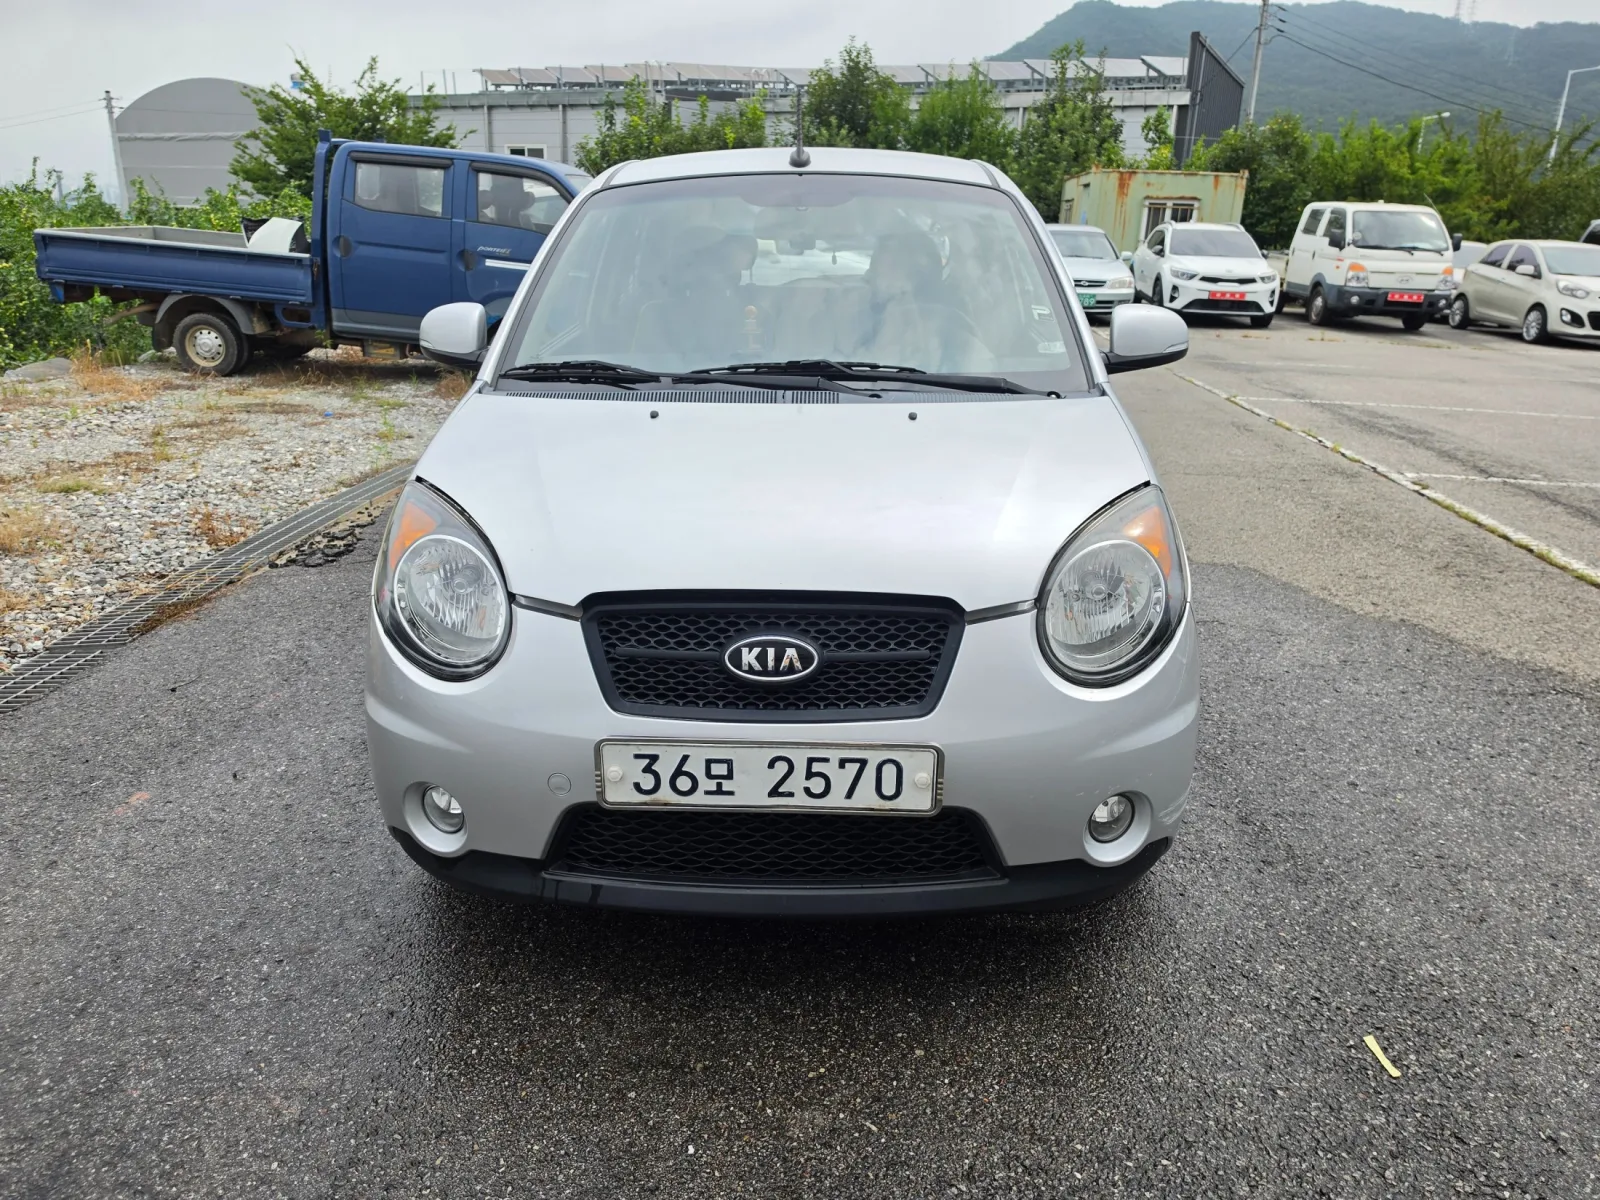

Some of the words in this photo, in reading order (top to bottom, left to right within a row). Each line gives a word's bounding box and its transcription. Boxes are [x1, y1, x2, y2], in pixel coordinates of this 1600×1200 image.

[740, 647, 803, 671] KIA
[632, 753, 736, 797] 36모
[766, 755, 905, 802] 2570
